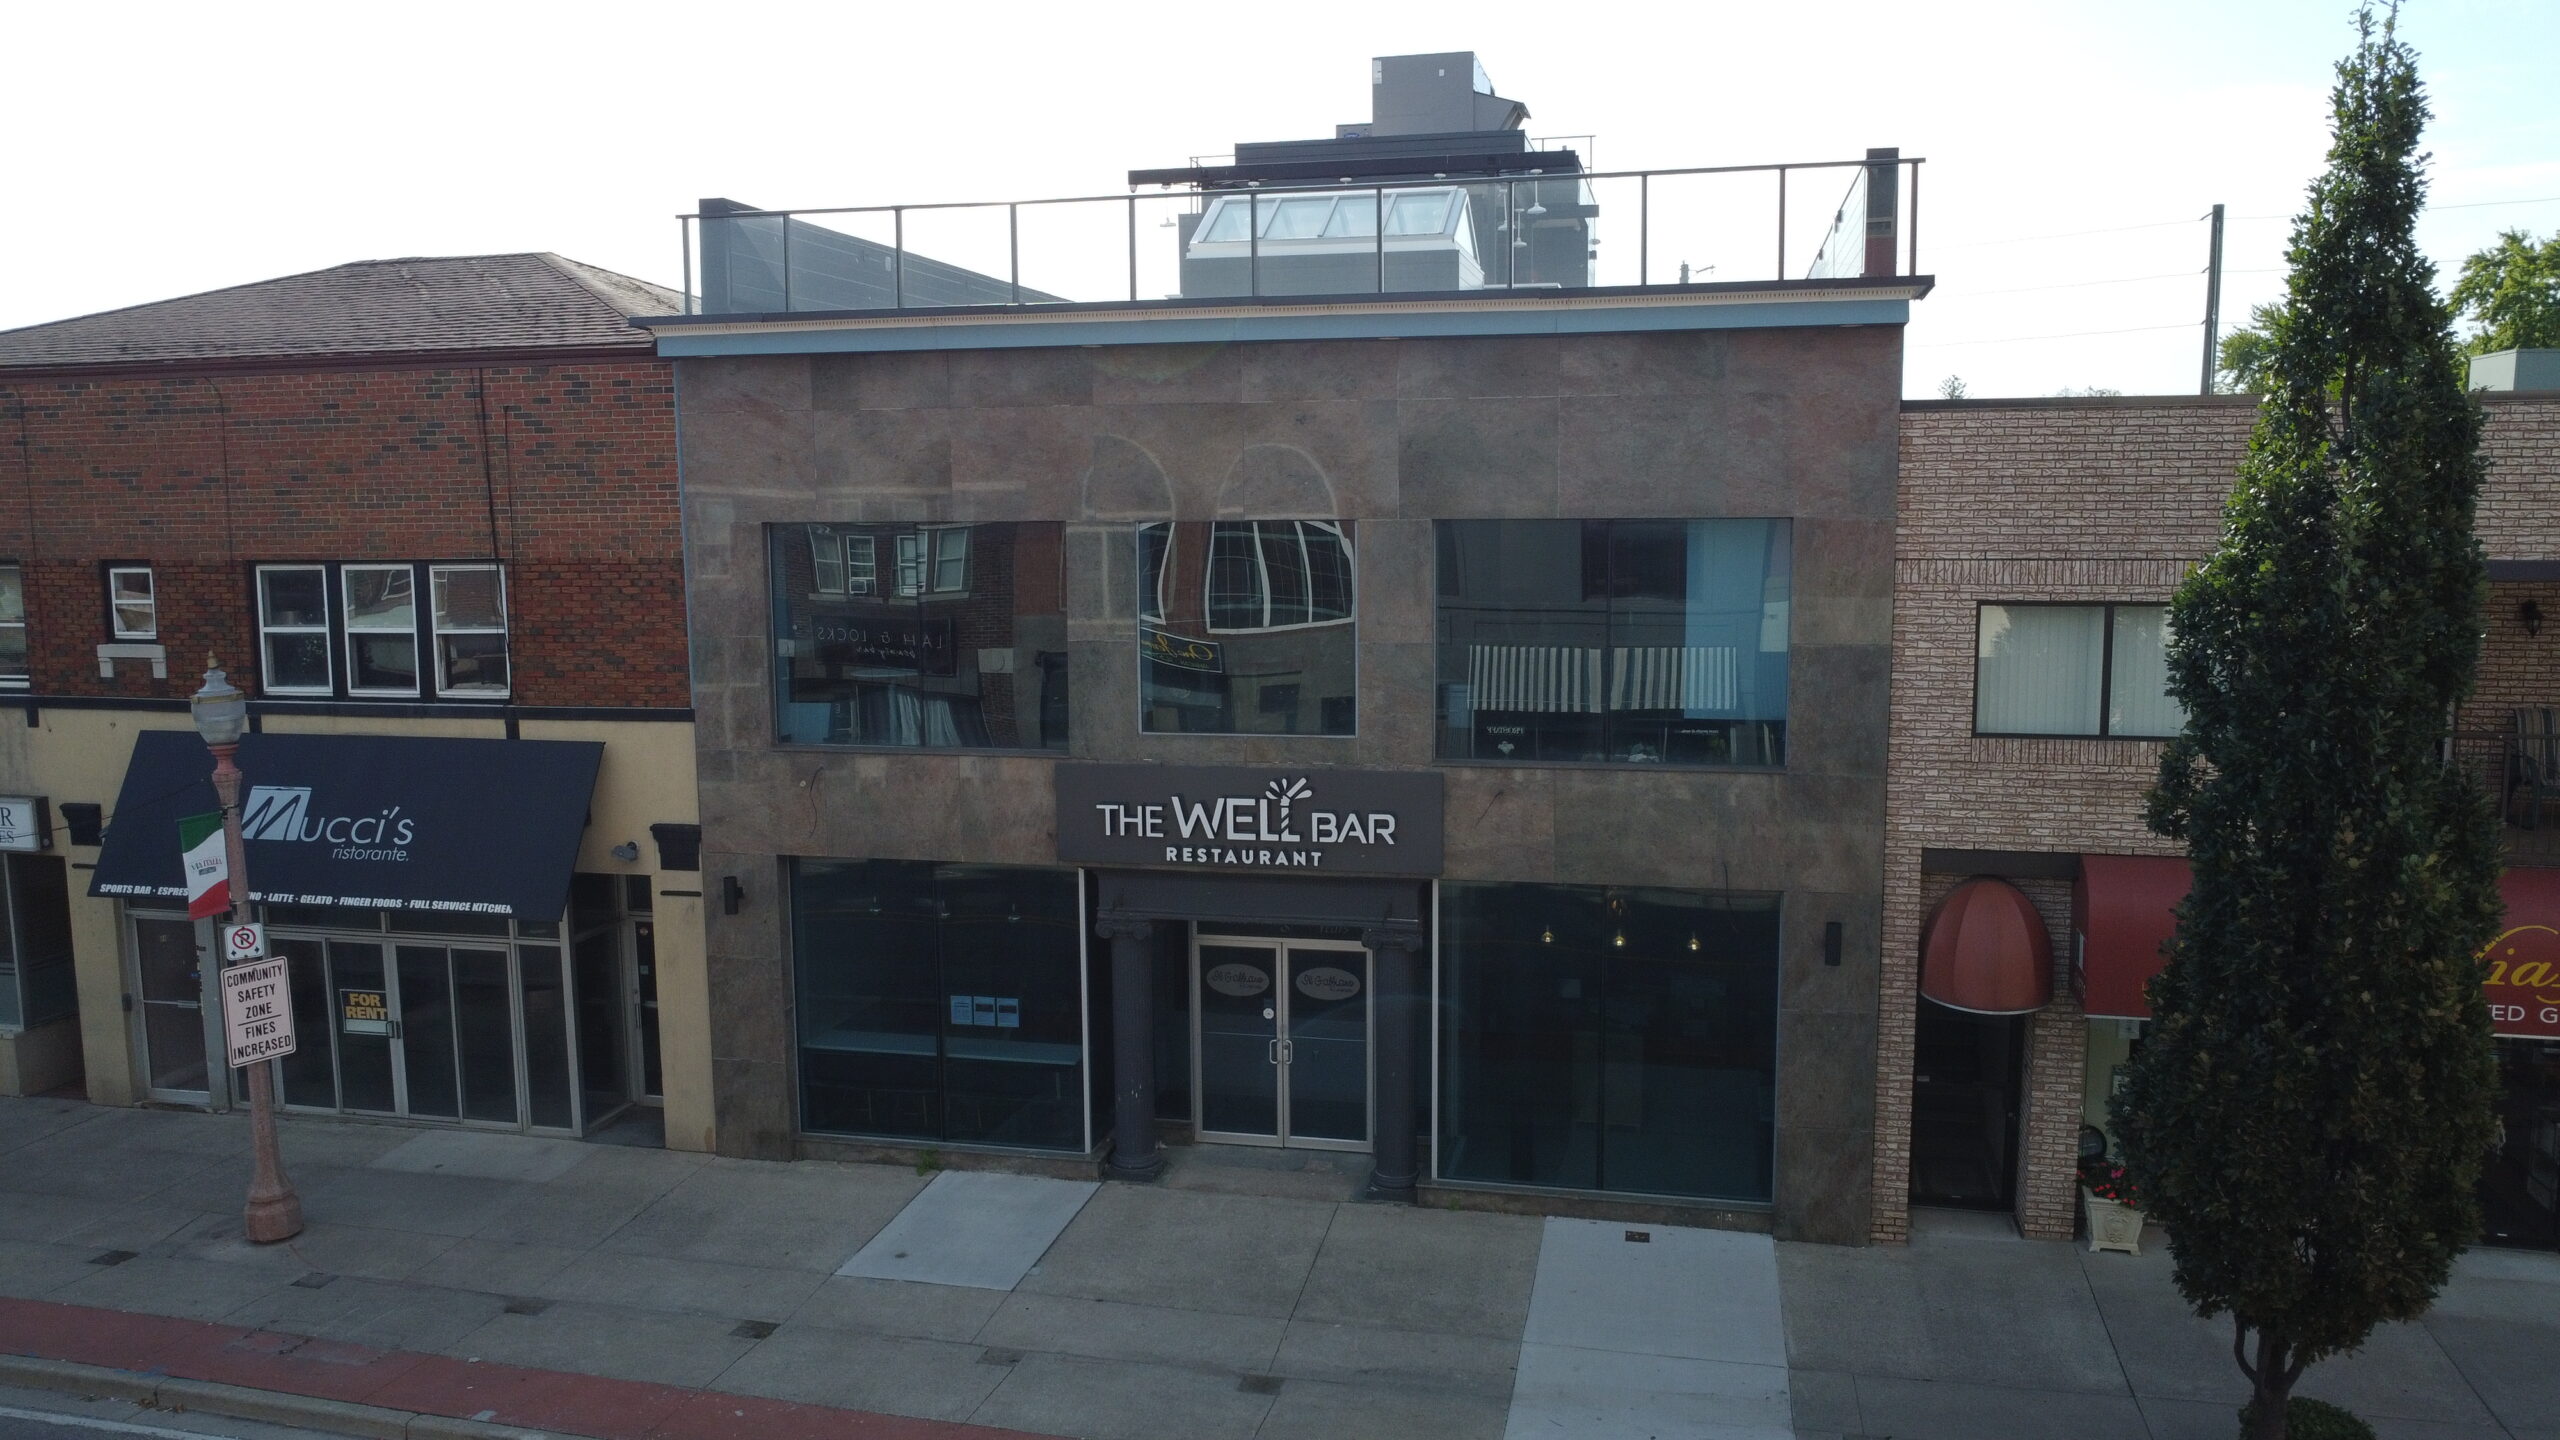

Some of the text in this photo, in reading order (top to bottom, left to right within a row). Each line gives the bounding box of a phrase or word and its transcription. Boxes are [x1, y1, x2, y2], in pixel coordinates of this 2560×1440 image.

[241, 786, 415, 845] Mucci's
[1096, 790, 1396, 845] THE WELL BAR
[332, 844, 409, 861] ristorante.
[1166, 846, 1322, 867] RESTAURANT
[100, 884, 132, 894] SPORTS
[133, 885, 152, 895] BAR
[157, 887, 189, 897] ESPRES
[268, 893, 294, 903] LATTE
[300, 894, 333, 905] GELATO
[339, 896, 371, 907] FINGER
[372, 898, 403, 908] FOODS
[409, 899, 430, 909] FULL
[431, 901, 471, 912] SERVICE
[472, 902, 513, 914] KITCHEN
[226, 964, 284, 988] COMMUNITY
[237, 983, 276, 1003] SAFETY
[349, 993, 381, 1007] FOR
[245, 1002, 273, 1019] ZONE
[345, 1006, 388, 1020] RENT
[2487, 1004, 2526, 1021] ED
[245, 1021, 277, 1039] FINES
[233, 1034, 292, 1060] INCREASED
